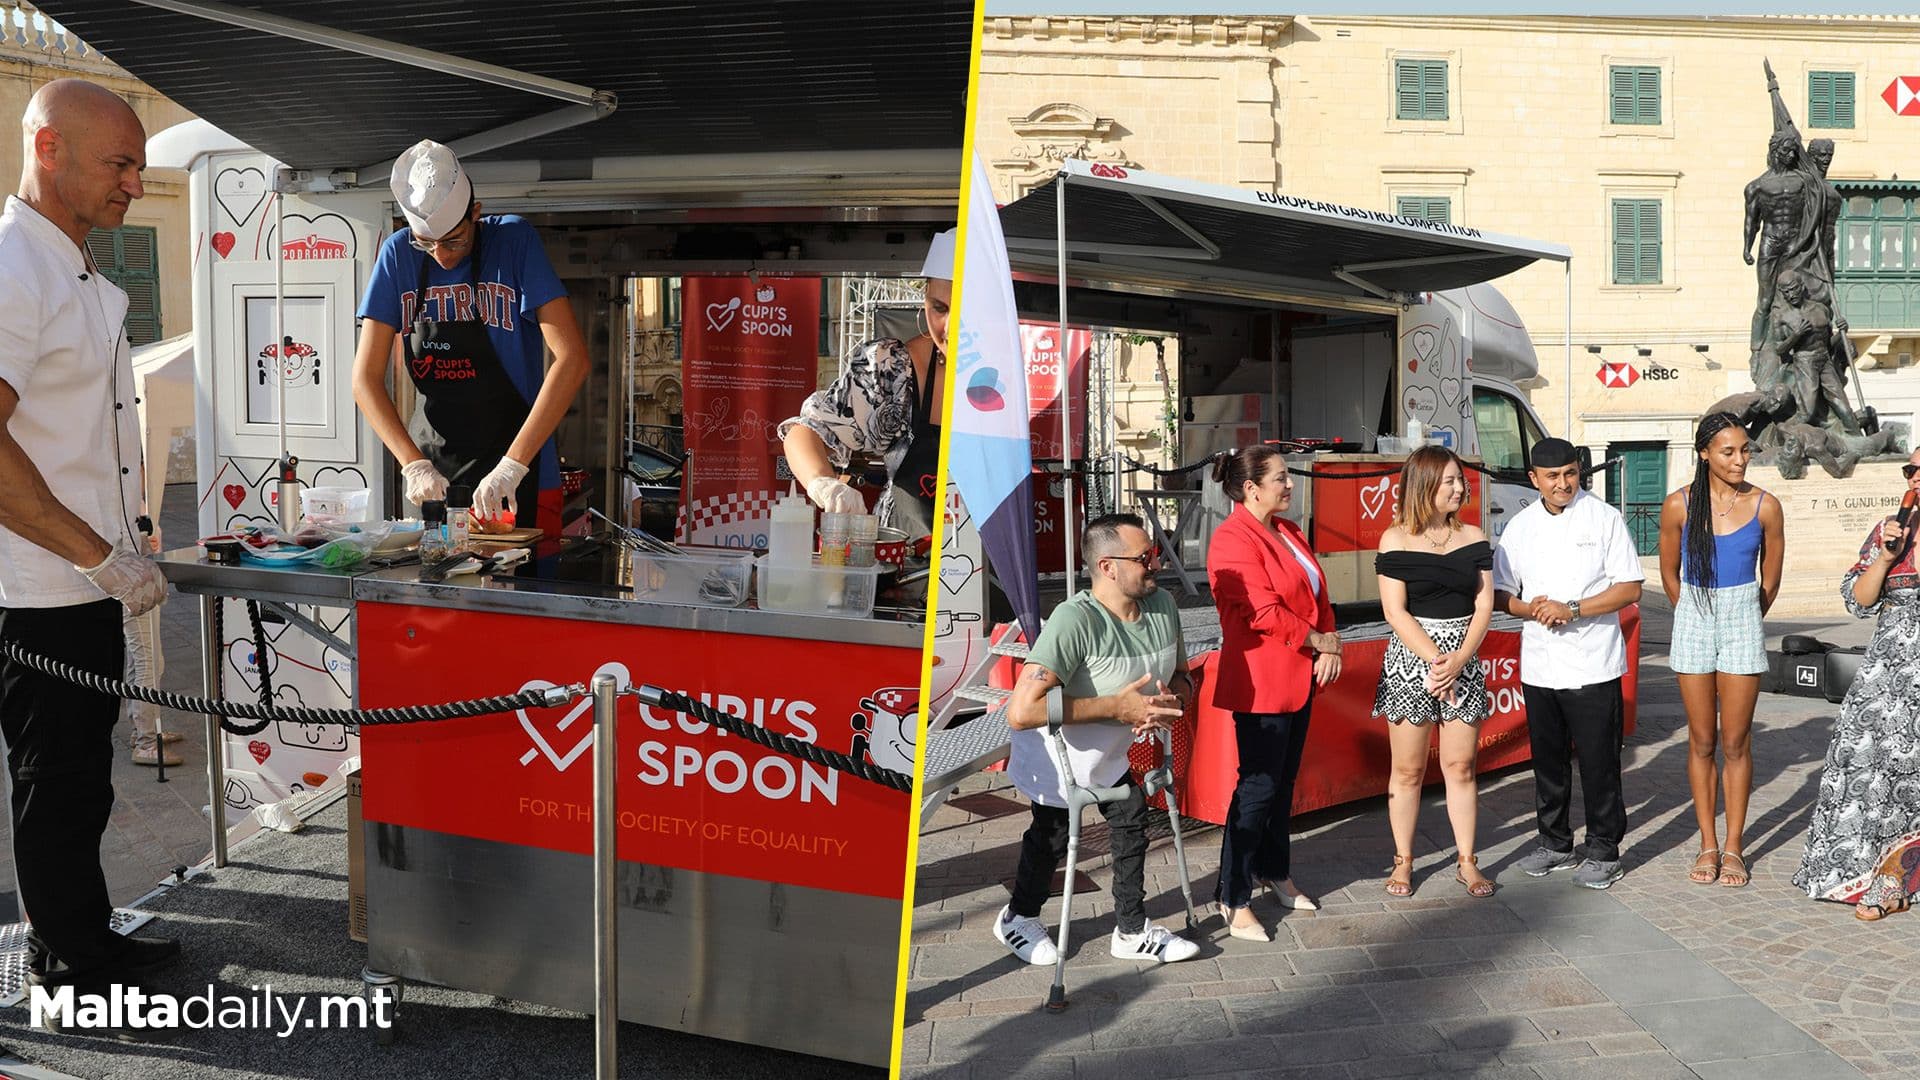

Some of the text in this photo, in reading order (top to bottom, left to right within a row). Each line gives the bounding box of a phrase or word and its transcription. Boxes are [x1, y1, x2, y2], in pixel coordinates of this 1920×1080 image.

[1256, 190, 1339, 215] EUROPEAN
[282, 247, 342, 261] PODRAVKA
[742, 304, 788, 321] CUPI'S
[741, 320, 793, 337] SPOON
[435, 359, 472, 369] CUPI'S
[1024, 364, 1062, 376] SPOO
[433, 369, 477, 380] SPOON
[1642, 368, 1679, 381] HSBC
[1811, 499, 1818, 510] 7
[1482, 657, 1518, 682] PI'S
[1486, 686, 1526, 717] OON
[636, 740, 840, 807] SPOON
[518, 797, 849, 857] FOR TH OCIETY OF EQUALITY
